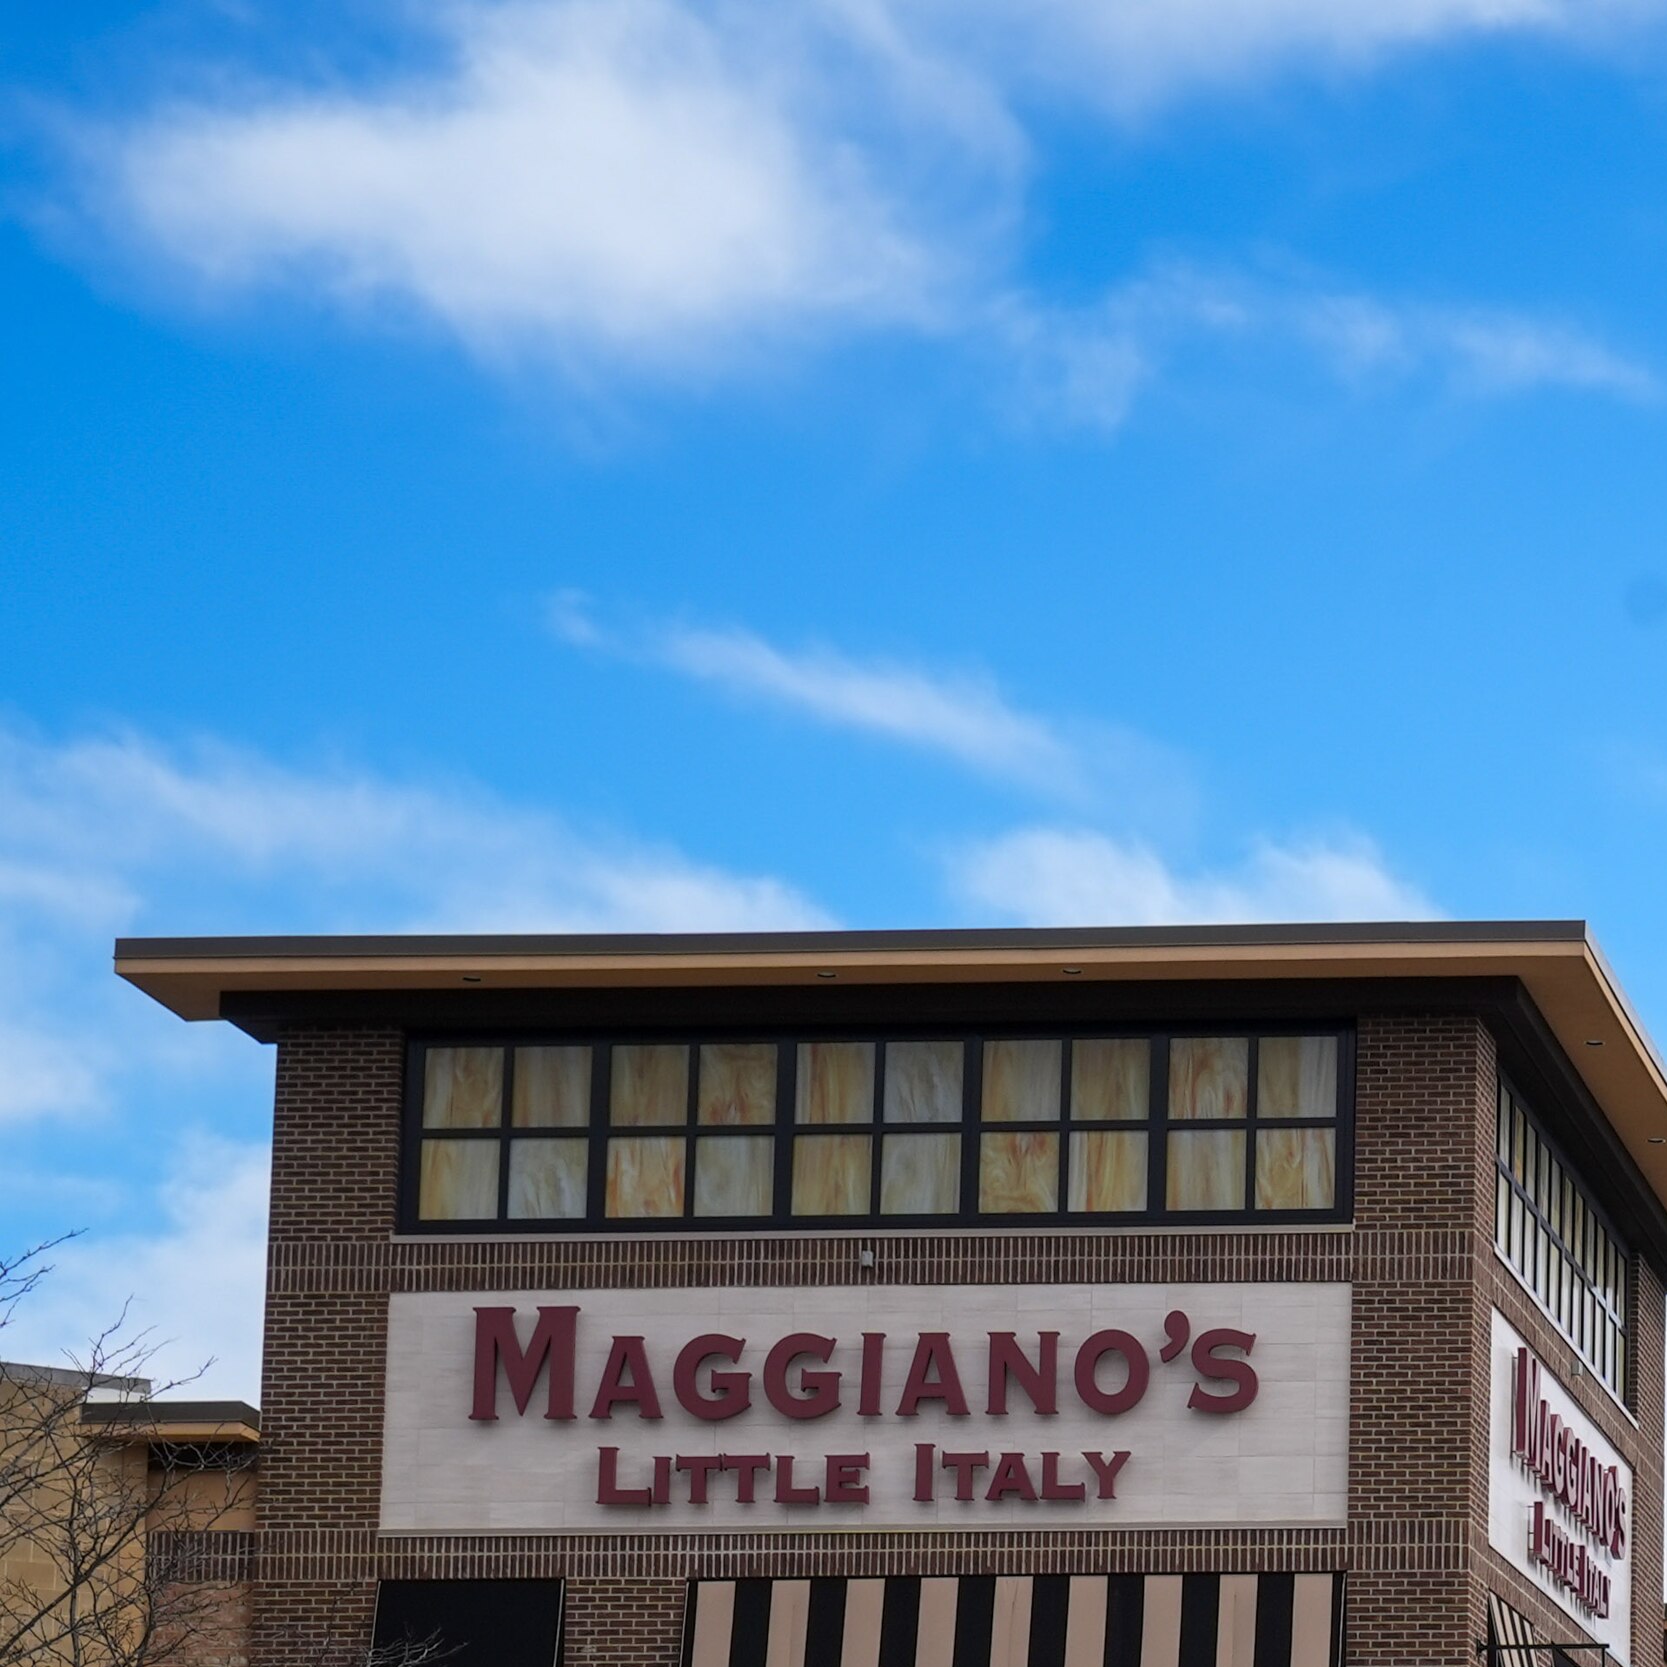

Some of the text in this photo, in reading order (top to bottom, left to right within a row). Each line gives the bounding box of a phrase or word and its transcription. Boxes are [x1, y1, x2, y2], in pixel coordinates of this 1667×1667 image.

[468, 1305, 1259, 1421] MAGGIANO'S
[596, 1443, 1132, 1506] LITTLE ITALY
[1516, 1347, 1627, 1560] MAGGIANO'S
[1533, 1501, 1612, 1620] LITTLE ITALY
